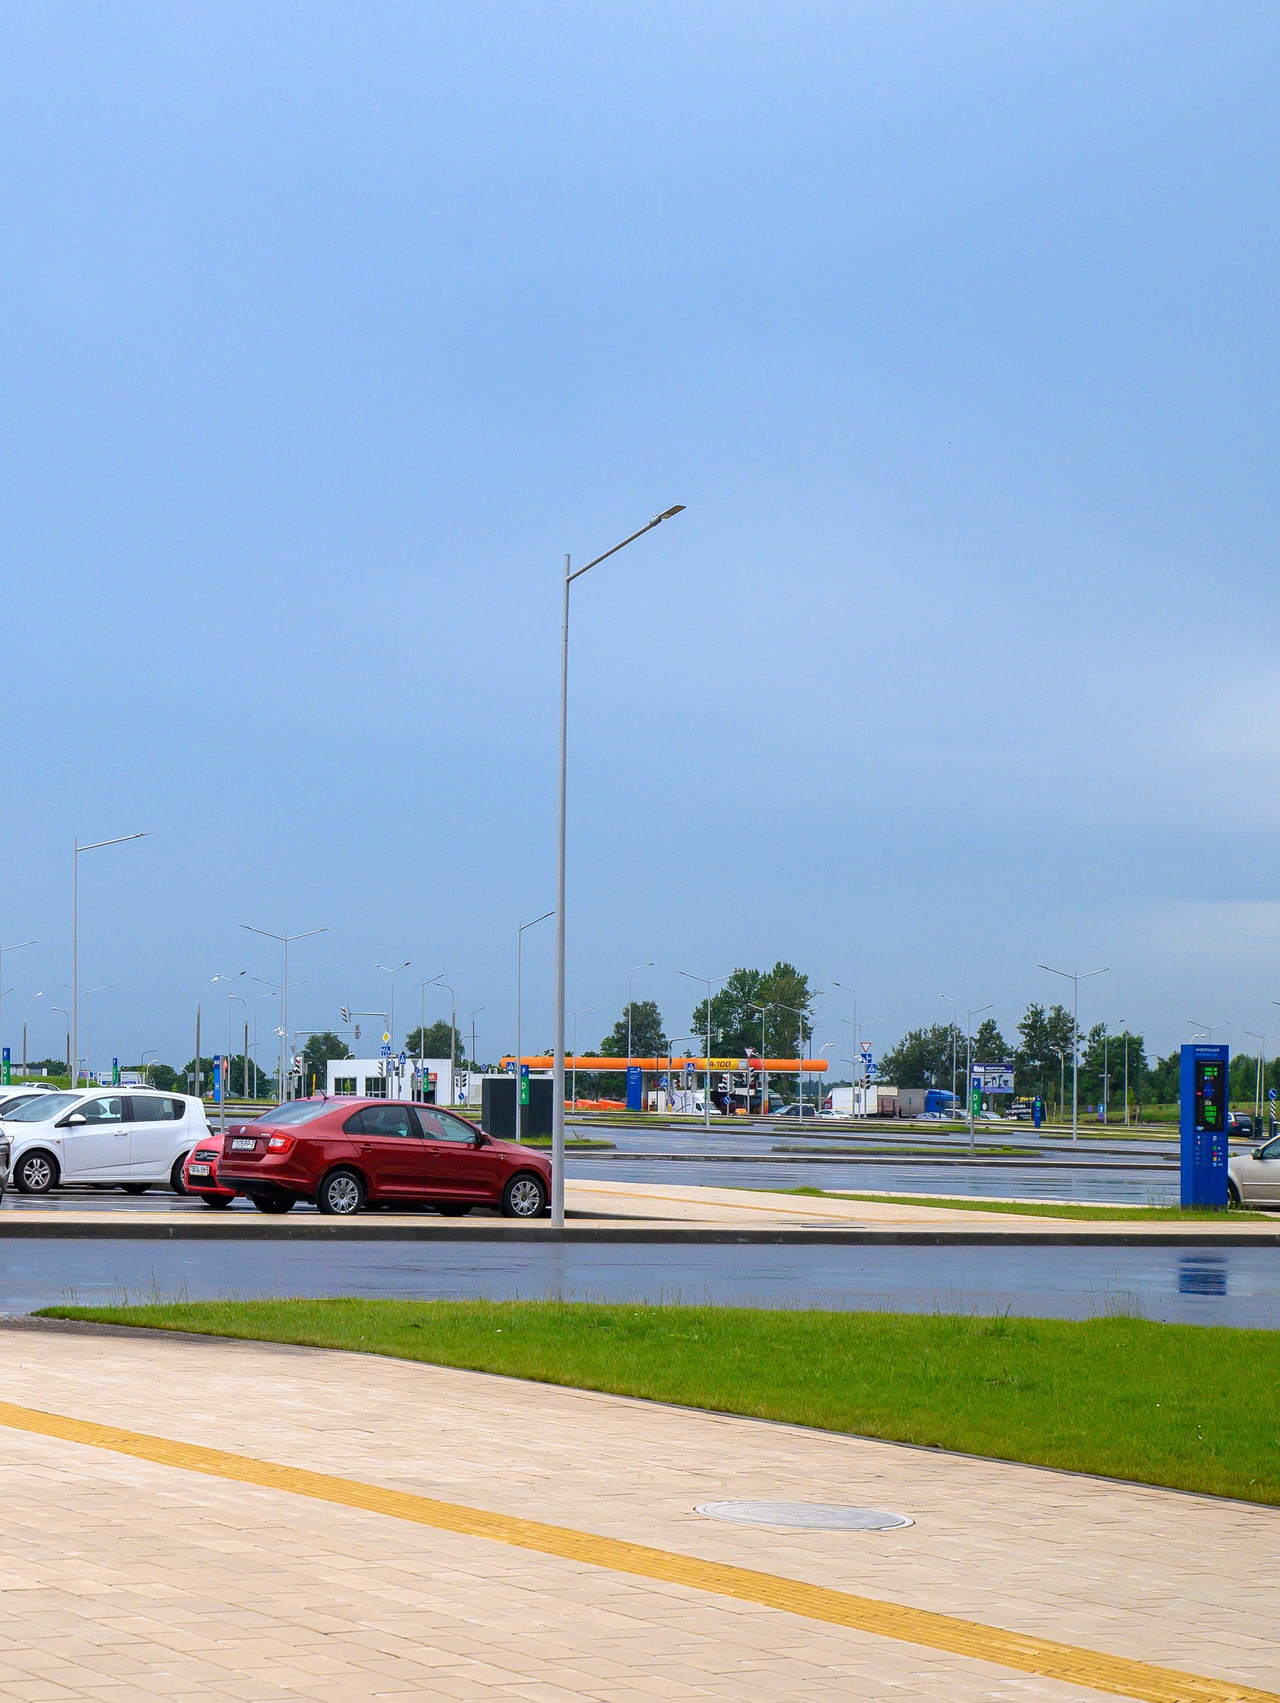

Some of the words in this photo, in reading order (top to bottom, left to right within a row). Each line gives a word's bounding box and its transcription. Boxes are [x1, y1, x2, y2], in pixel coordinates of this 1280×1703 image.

[709, 1060, 732, 1068] A-100
[521, 1081, 527, 1090] D
[521, 1092, 526, 1100] 6
[973, 1093, 979, 1101] D
